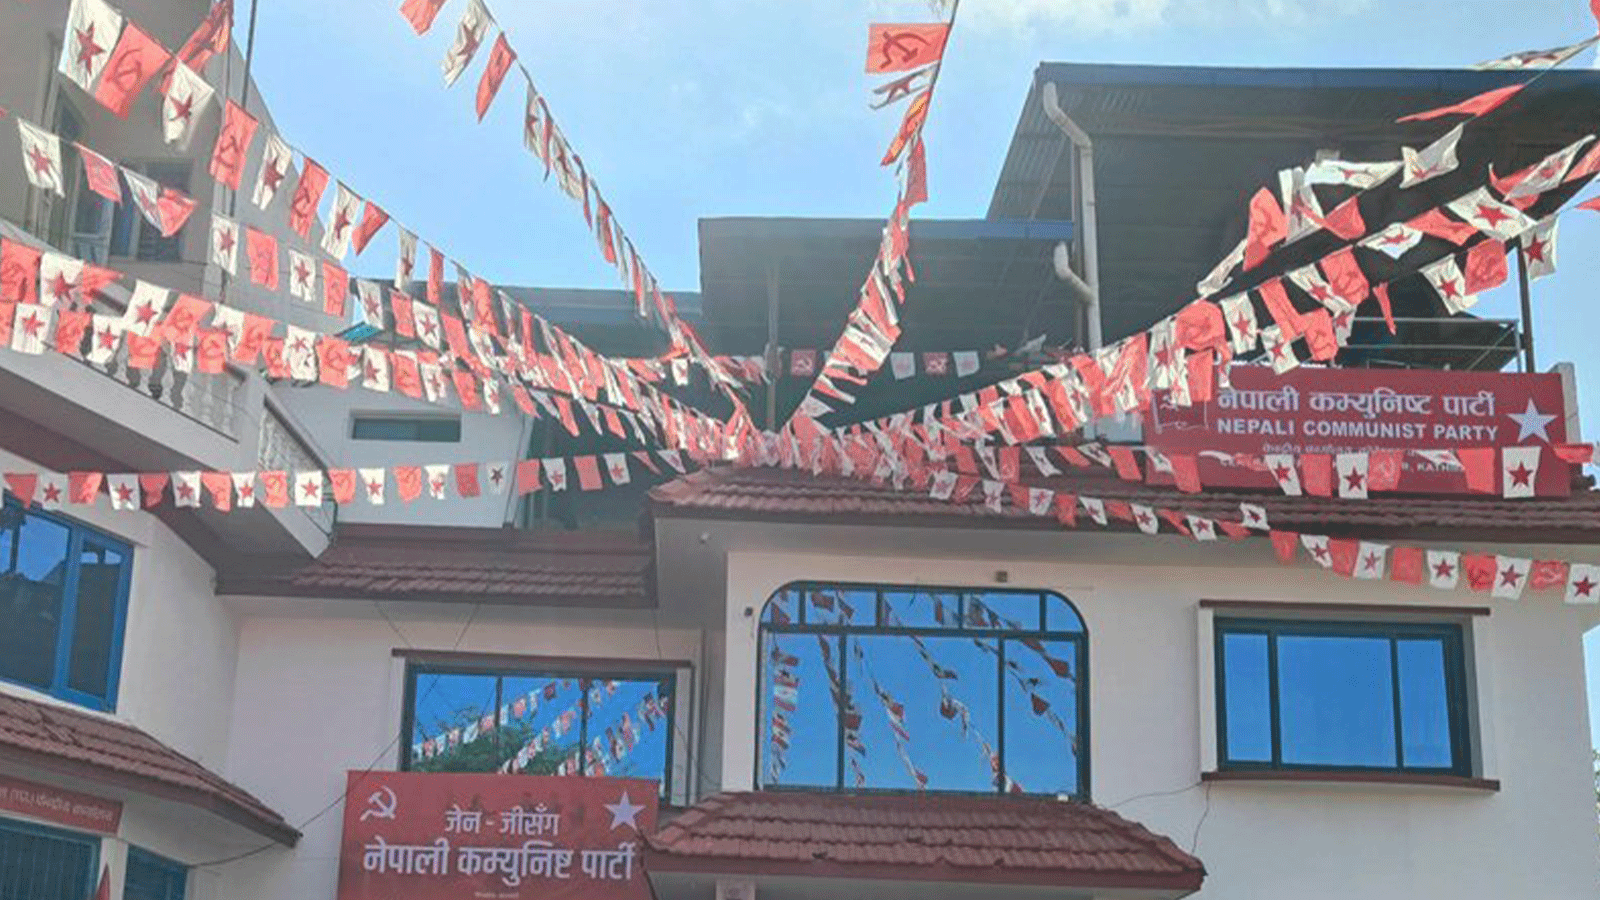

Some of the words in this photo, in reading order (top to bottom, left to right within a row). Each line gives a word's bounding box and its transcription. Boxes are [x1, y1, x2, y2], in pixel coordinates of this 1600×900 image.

[1217, 385, 1300, 411] नेपाली
[1309, 387, 1432, 418] कम्युनिष्ट
[1443, 390, 1495, 416] पार्टी
[1217, 418, 1295, 435] NEPALI
[1303, 420, 1427, 438] COMMUNIST
[1433, 424, 1499, 441] PARTY
[444, 804, 483, 834] जेन
[499, 803, 561, 836] जीसँग
[363, 835, 450, 875] नेपाली
[457, 839, 574, 886] कम्युनिष्ट
[581, 842, 636, 880] पार्टी
